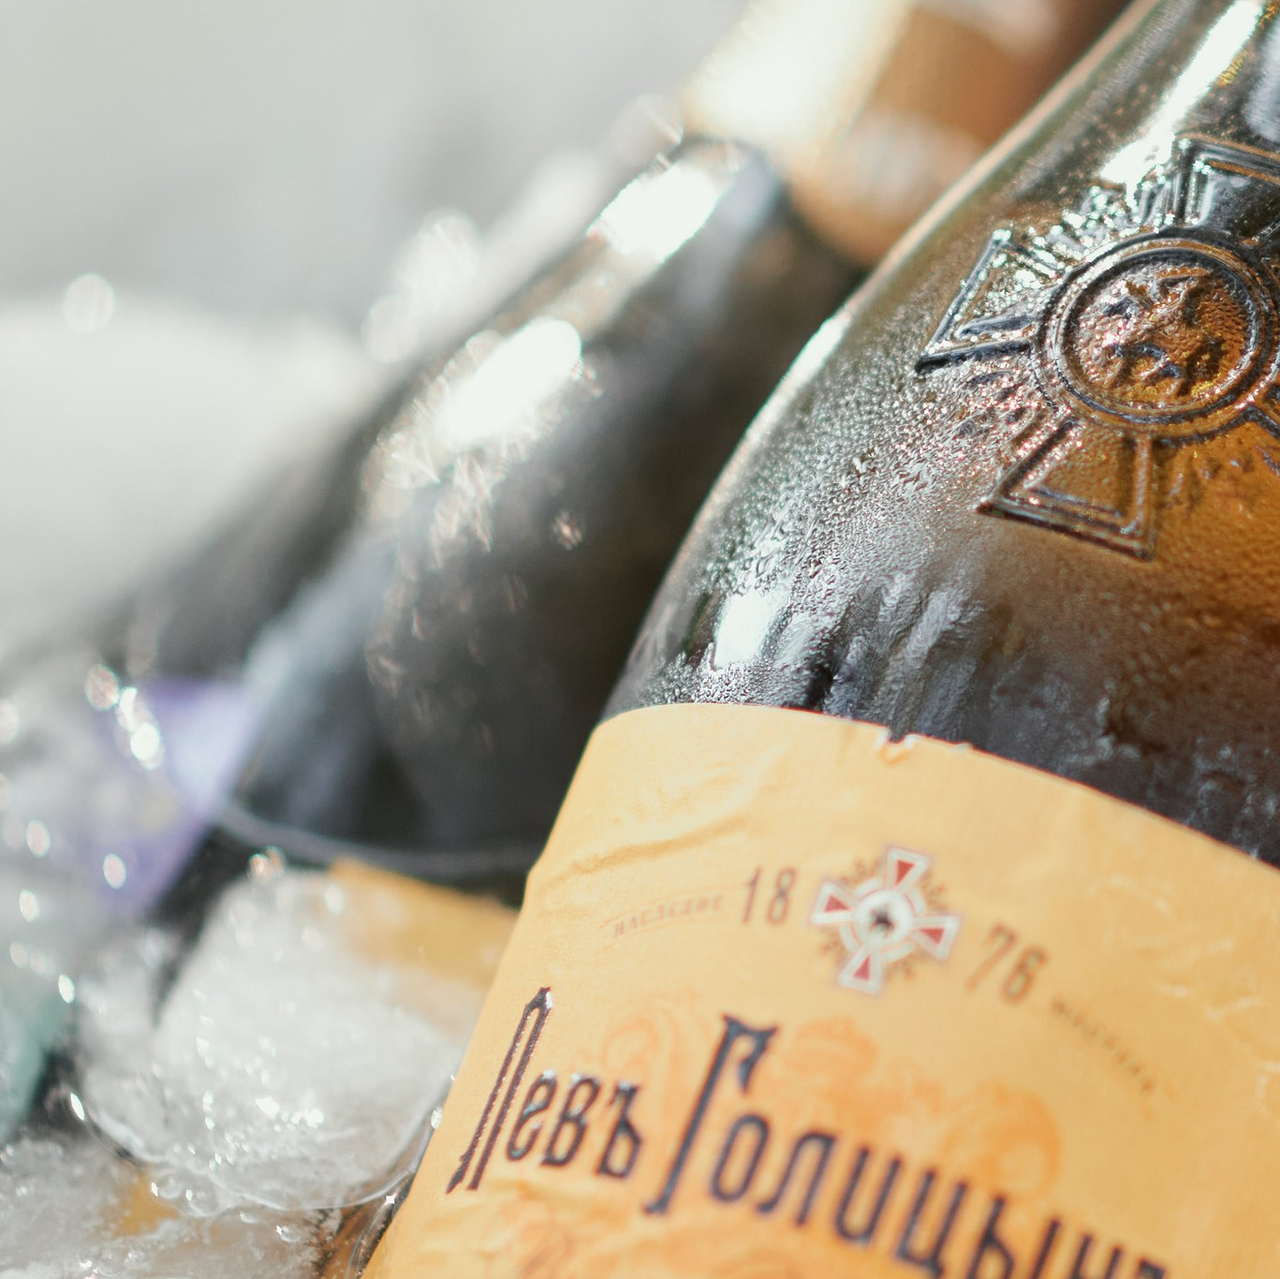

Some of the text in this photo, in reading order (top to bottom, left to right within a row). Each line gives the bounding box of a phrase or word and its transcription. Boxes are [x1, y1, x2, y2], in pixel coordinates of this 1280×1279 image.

[740, 865, 795, 926] 18
[966, 923, 1049, 1005] 76
[446, 986, 645, 1196] Левъ
